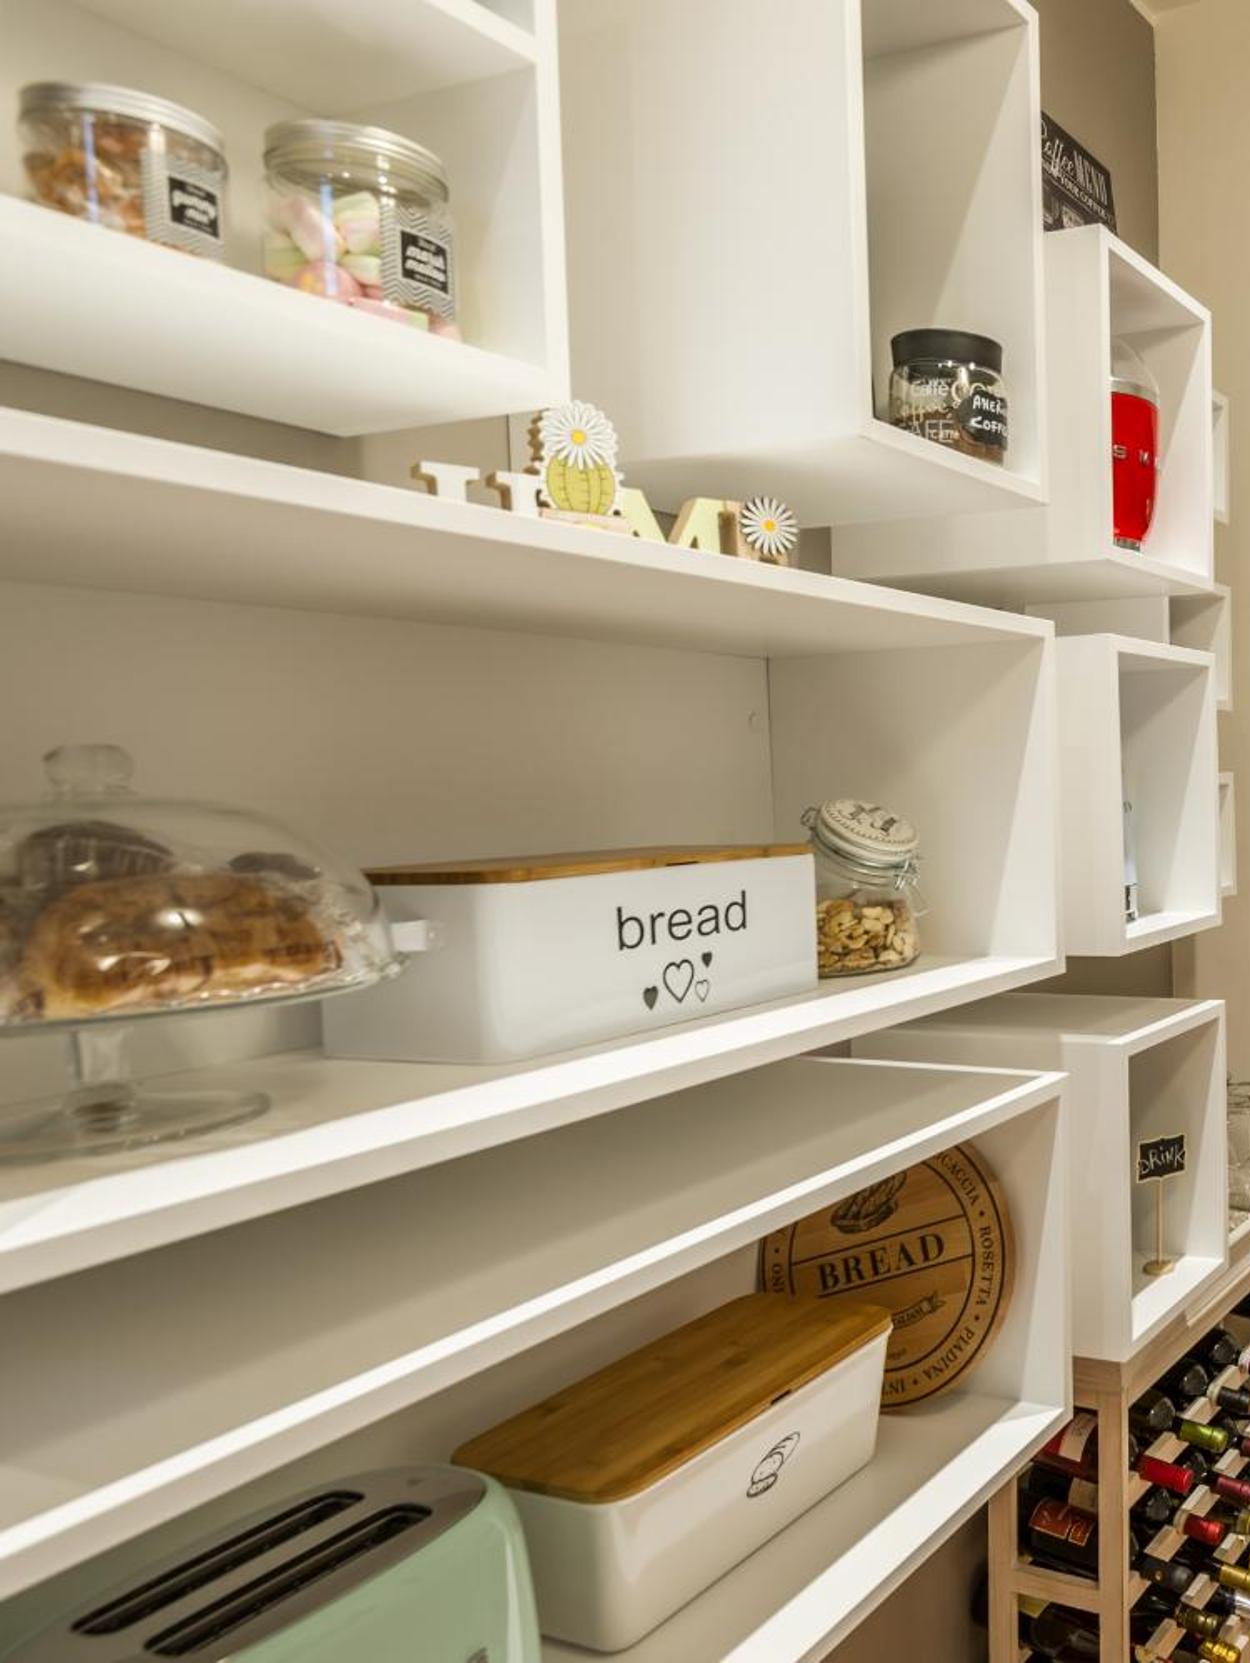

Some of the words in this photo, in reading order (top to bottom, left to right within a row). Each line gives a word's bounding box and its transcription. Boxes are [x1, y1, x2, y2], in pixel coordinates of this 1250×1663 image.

[616, 890, 747, 951] bread
[816, 1232, 945, 1292] BREAD
[976, 1226, 995, 1306] ROSETTA
[922, 1329, 975, 1381] PIADINA
